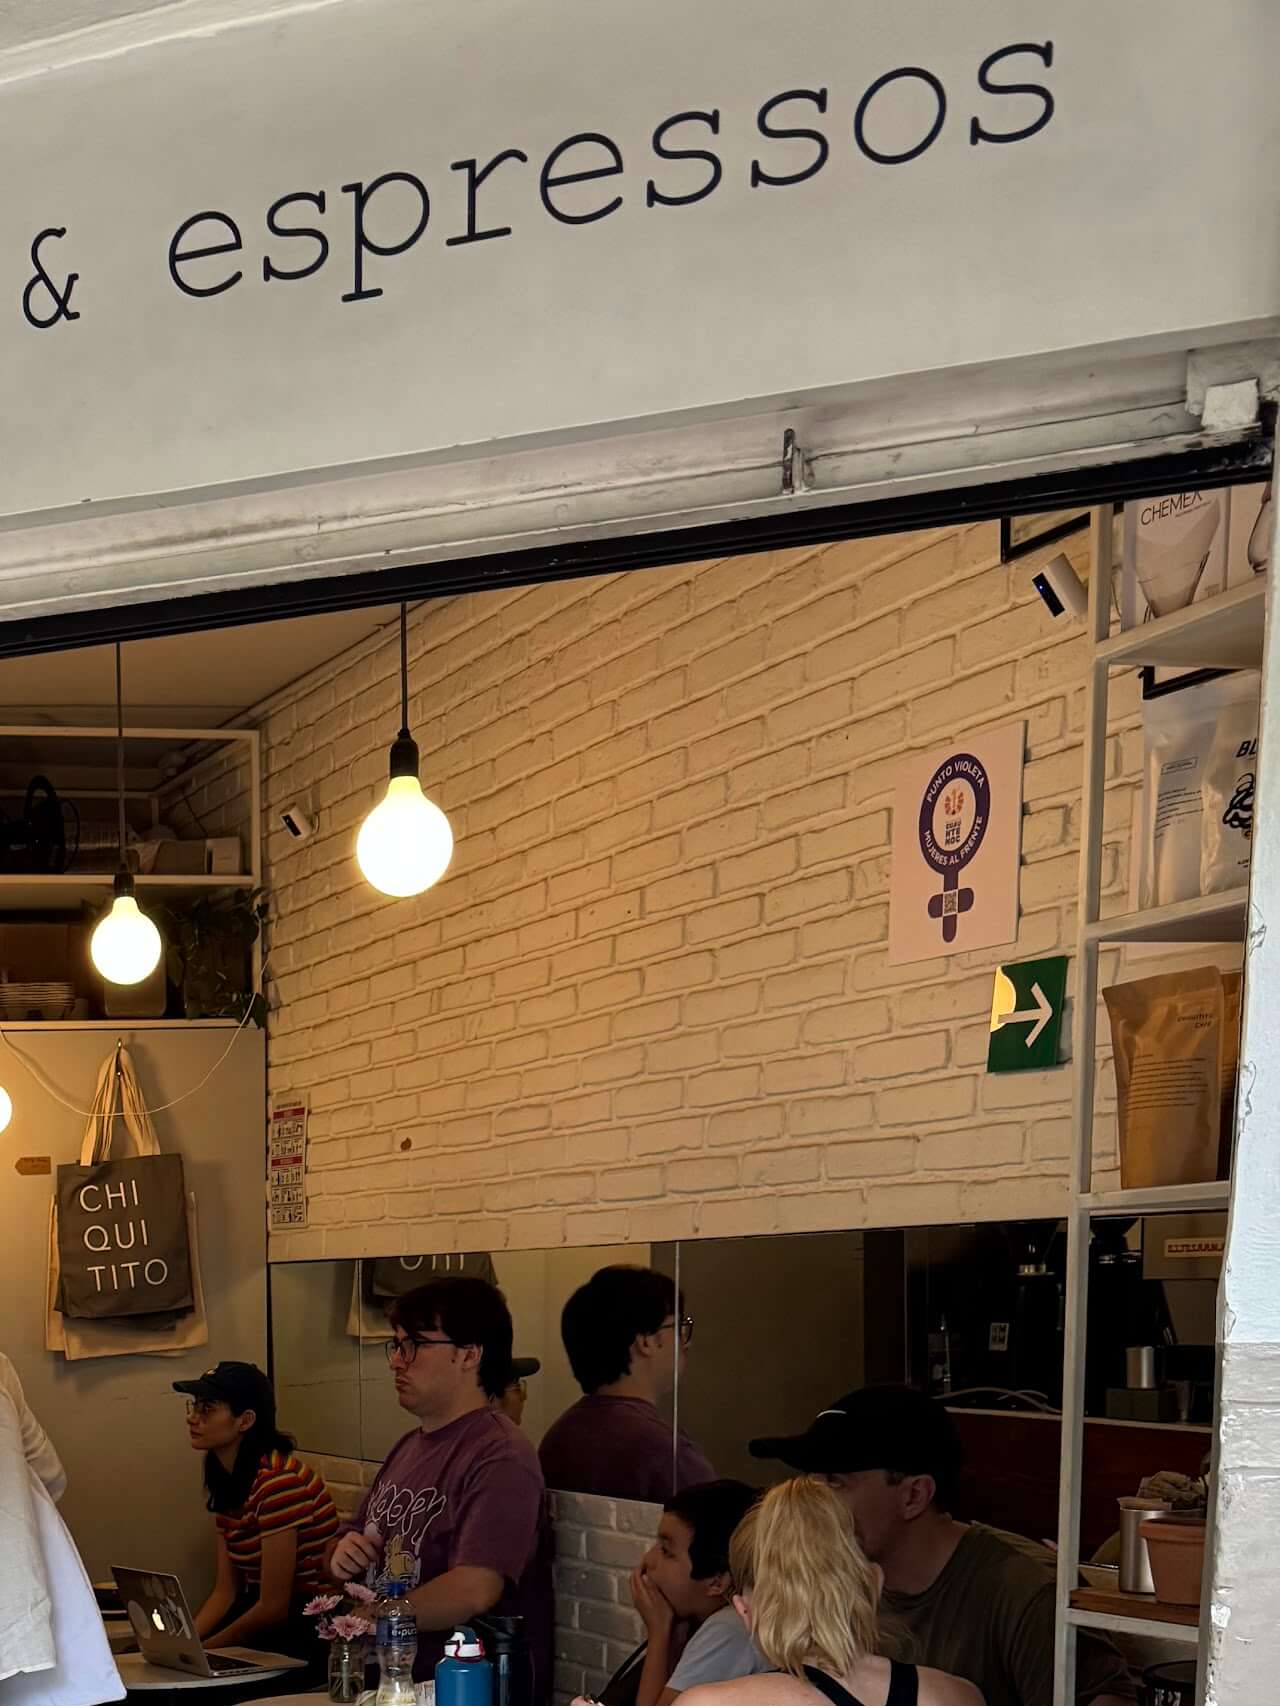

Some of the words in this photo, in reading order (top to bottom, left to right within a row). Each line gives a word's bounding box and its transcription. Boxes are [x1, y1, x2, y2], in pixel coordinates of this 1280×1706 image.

[22, 227, 81, 329] &
[168, 40, 1055, 303] espressos
[926, 765, 952, 803] PUNTO
[954, 760, 985, 789] VIOLETA
[924, 829, 948, 866] MUJERES
[949, 854, 960, 866] AL
[960, 815, 982, 859] FRENTE
[79, 1179, 139, 1212] CHI
[83, 1219, 148, 1252] QUI
[87, 1258, 168, 1291] TITO
